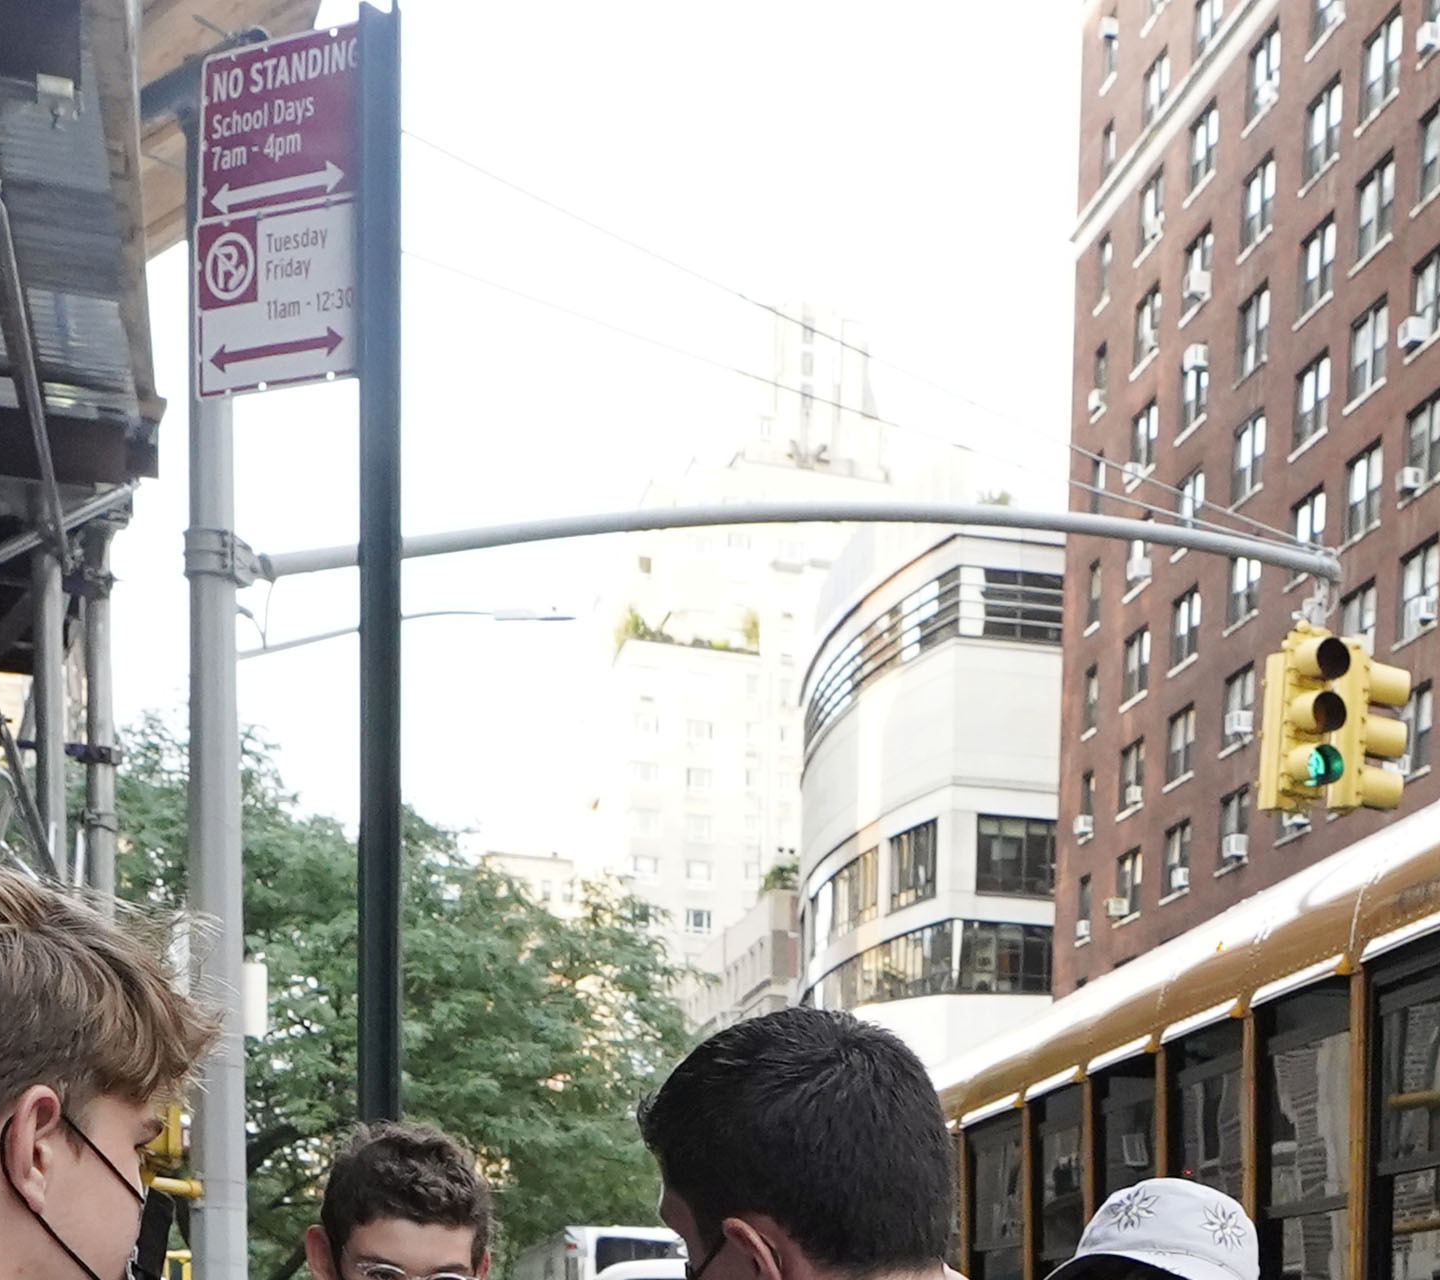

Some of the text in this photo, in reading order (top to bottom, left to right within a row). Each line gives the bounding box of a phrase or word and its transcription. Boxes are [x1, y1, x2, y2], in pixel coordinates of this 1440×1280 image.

[213, 37, 358, 103] NO STANDING
[212, 96, 315, 140] School Days
[211, 146, 248, 172] 7am
[263, 132, 302, 163] 4pm
[266, 227, 328, 254] Tuesday
[265, 257, 311, 281] Friday
[267, 299, 301, 321] 11am
